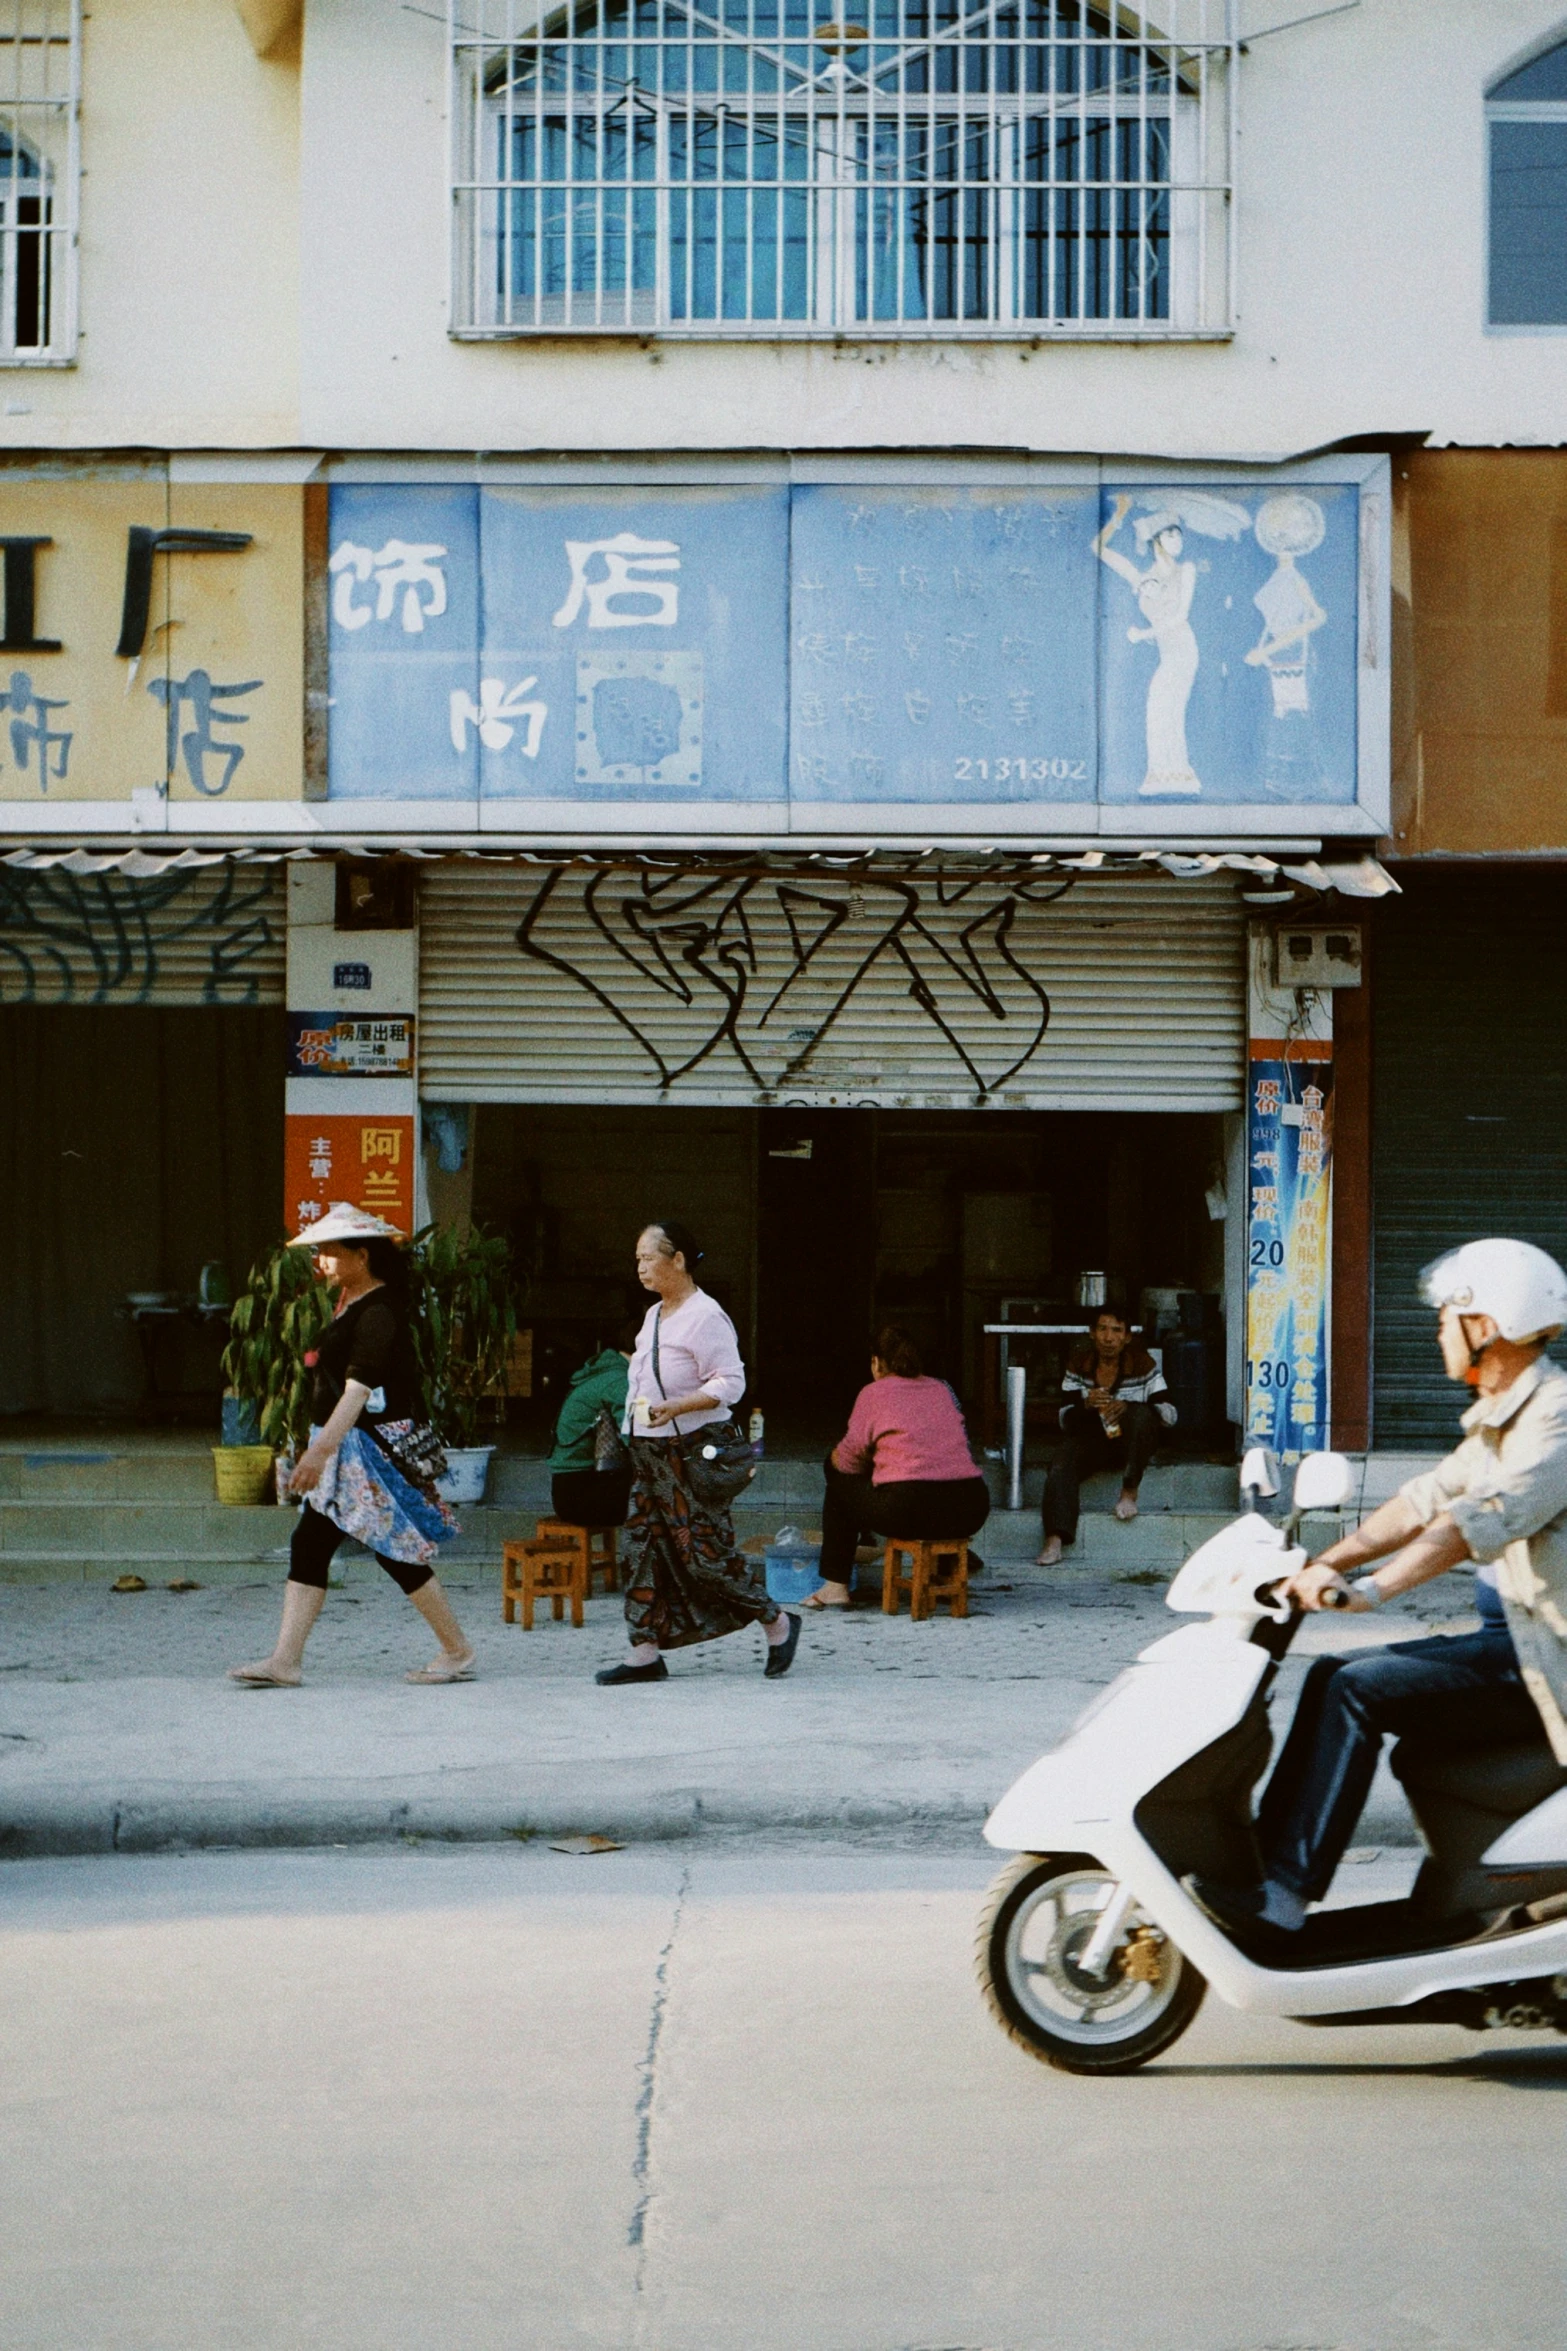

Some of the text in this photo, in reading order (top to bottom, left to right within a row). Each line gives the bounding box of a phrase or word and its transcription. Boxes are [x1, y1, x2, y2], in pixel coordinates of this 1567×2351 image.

[954, 757, 1088, 781] 2131302
[296, 1029, 336, 1066] 原价
[338, 1023, 406, 1042] 房屋出租
[360, 1128, 403, 1223] 阿兰
